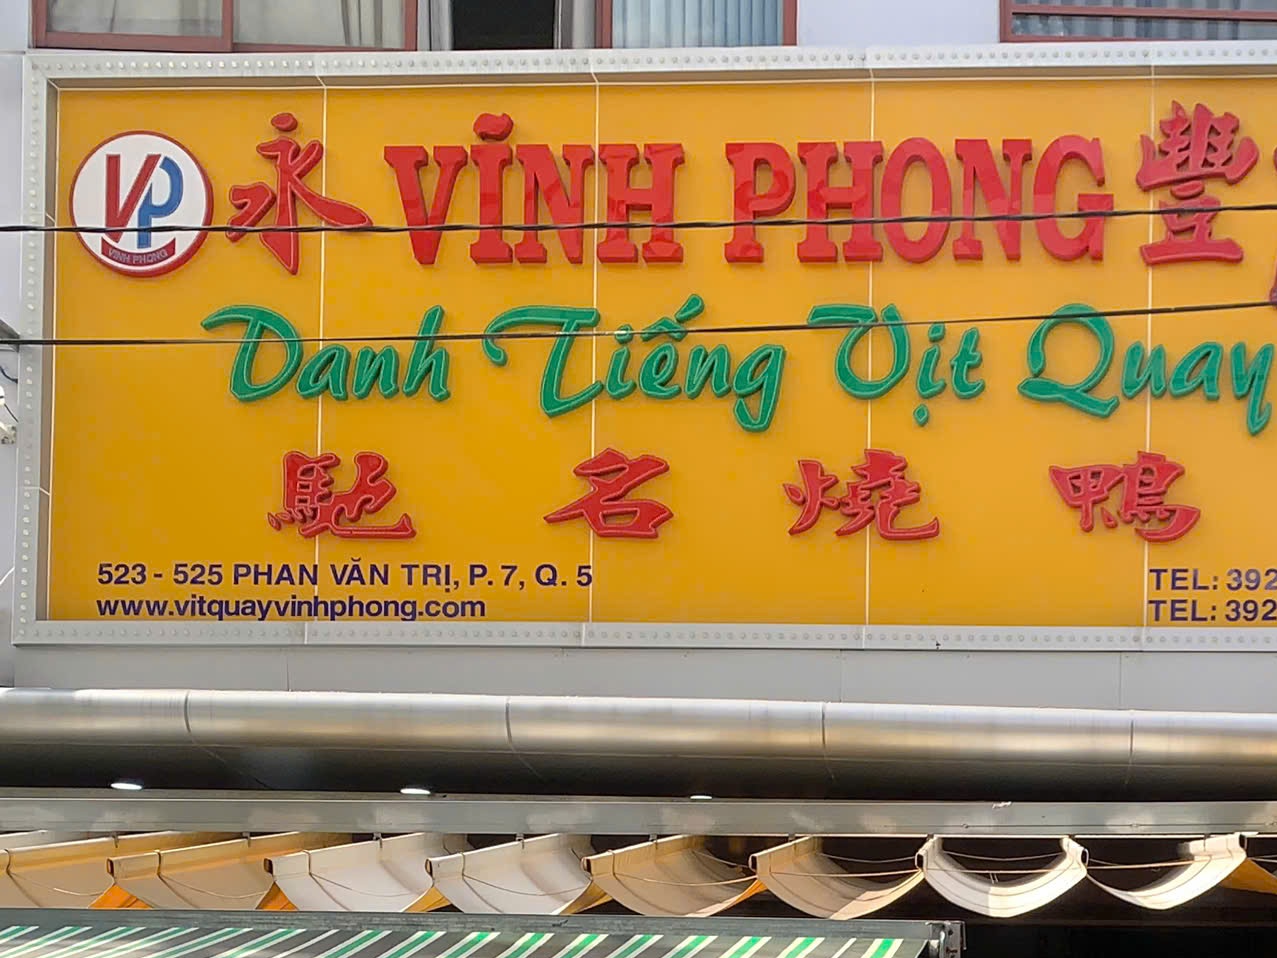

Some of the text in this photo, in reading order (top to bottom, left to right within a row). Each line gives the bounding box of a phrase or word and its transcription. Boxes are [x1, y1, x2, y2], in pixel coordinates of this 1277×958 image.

[228, 112, 374, 275] 永
[725, 135, 1114, 264] PHONG
[1136, 99, 1259, 267] 豐
[132, 248, 169, 264] PHONG
[201, 294, 1275, 436] Danh Tiếng Vịt Quay
[98, 563, 146, 585] 523
[173, 563, 223, 585] 525
[233, 563, 319, 585] PHAN
[330, 557, 389, 585] VĂN
[401, 564, 459, 593] TRỊ,
[1150, 568, 1218, 590] TEL:
[97, 594, 486, 622] www.vitquayvinhphong.com
[1149, 599, 1217, 622] TEL:
